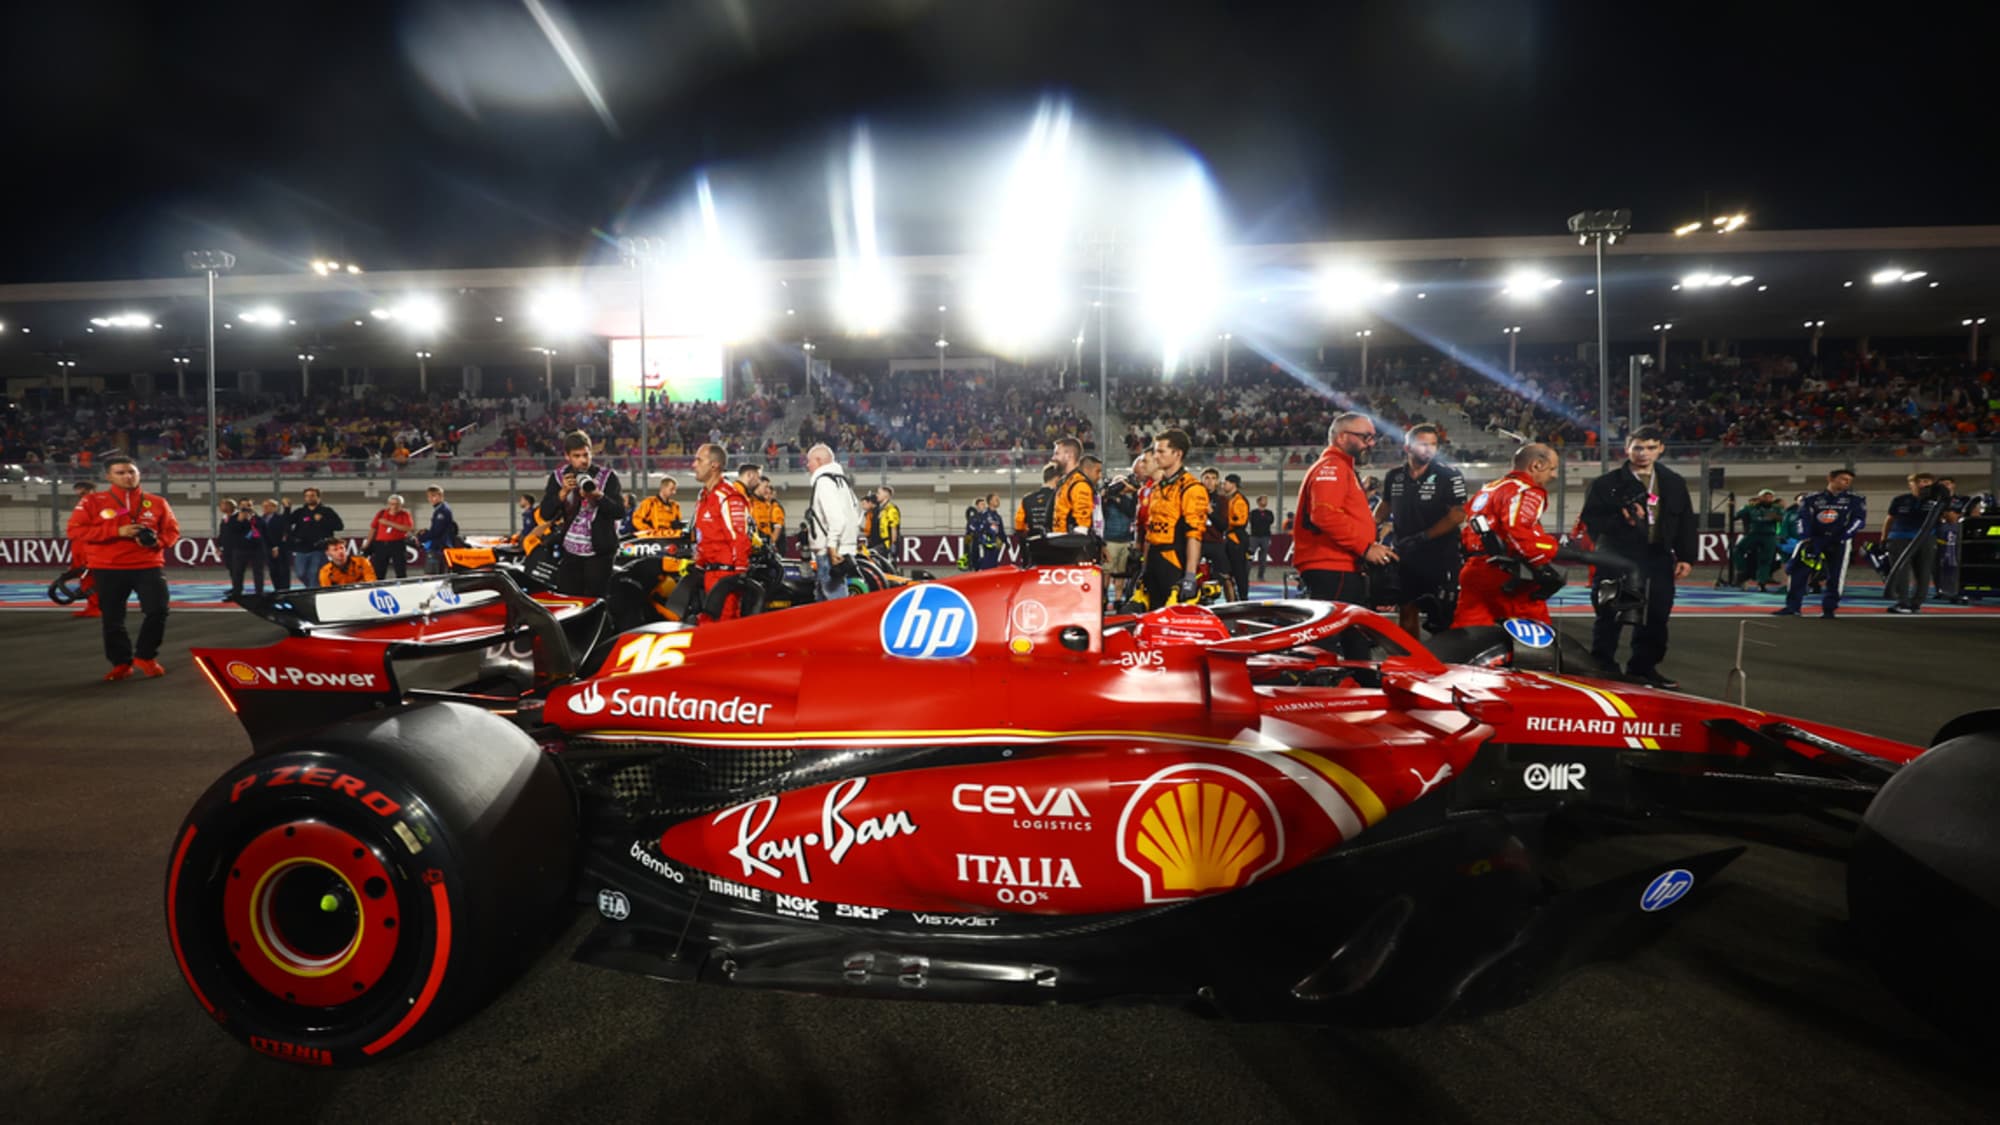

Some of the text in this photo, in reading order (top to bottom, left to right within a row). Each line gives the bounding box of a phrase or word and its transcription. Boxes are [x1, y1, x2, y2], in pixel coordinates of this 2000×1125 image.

[0, 539, 73, 564] AIRW
[1038, 568, 1084, 585] ZCG
[369, 589, 400, 615] hp
[892, 584, 964, 657] hp
[1513, 619, 1554, 646] hp
[1121, 650, 1164, 666] aws
[257, 666, 376, 688] V-Power
[610, 688, 772, 726] Santander
[1274, 701, 1325, 712] HARMAN
[1526, 716, 1682, 737] RICHARD MILLE
[231, 765, 402, 817] P ZERO
[1013, 818, 1092, 832] LOGISTICS
[630, 840, 685, 884] brembo
[956, 853, 1082, 888] ITALIA
[708, 878, 761, 902] MAHLE
[996, 888, 1049, 905] 0.0%
[1643, 869, 1691, 911] hp
[599, 894, 627, 915] FIA
[776, 893, 819, 914] NGK
[835, 903, 889, 919] SKF
